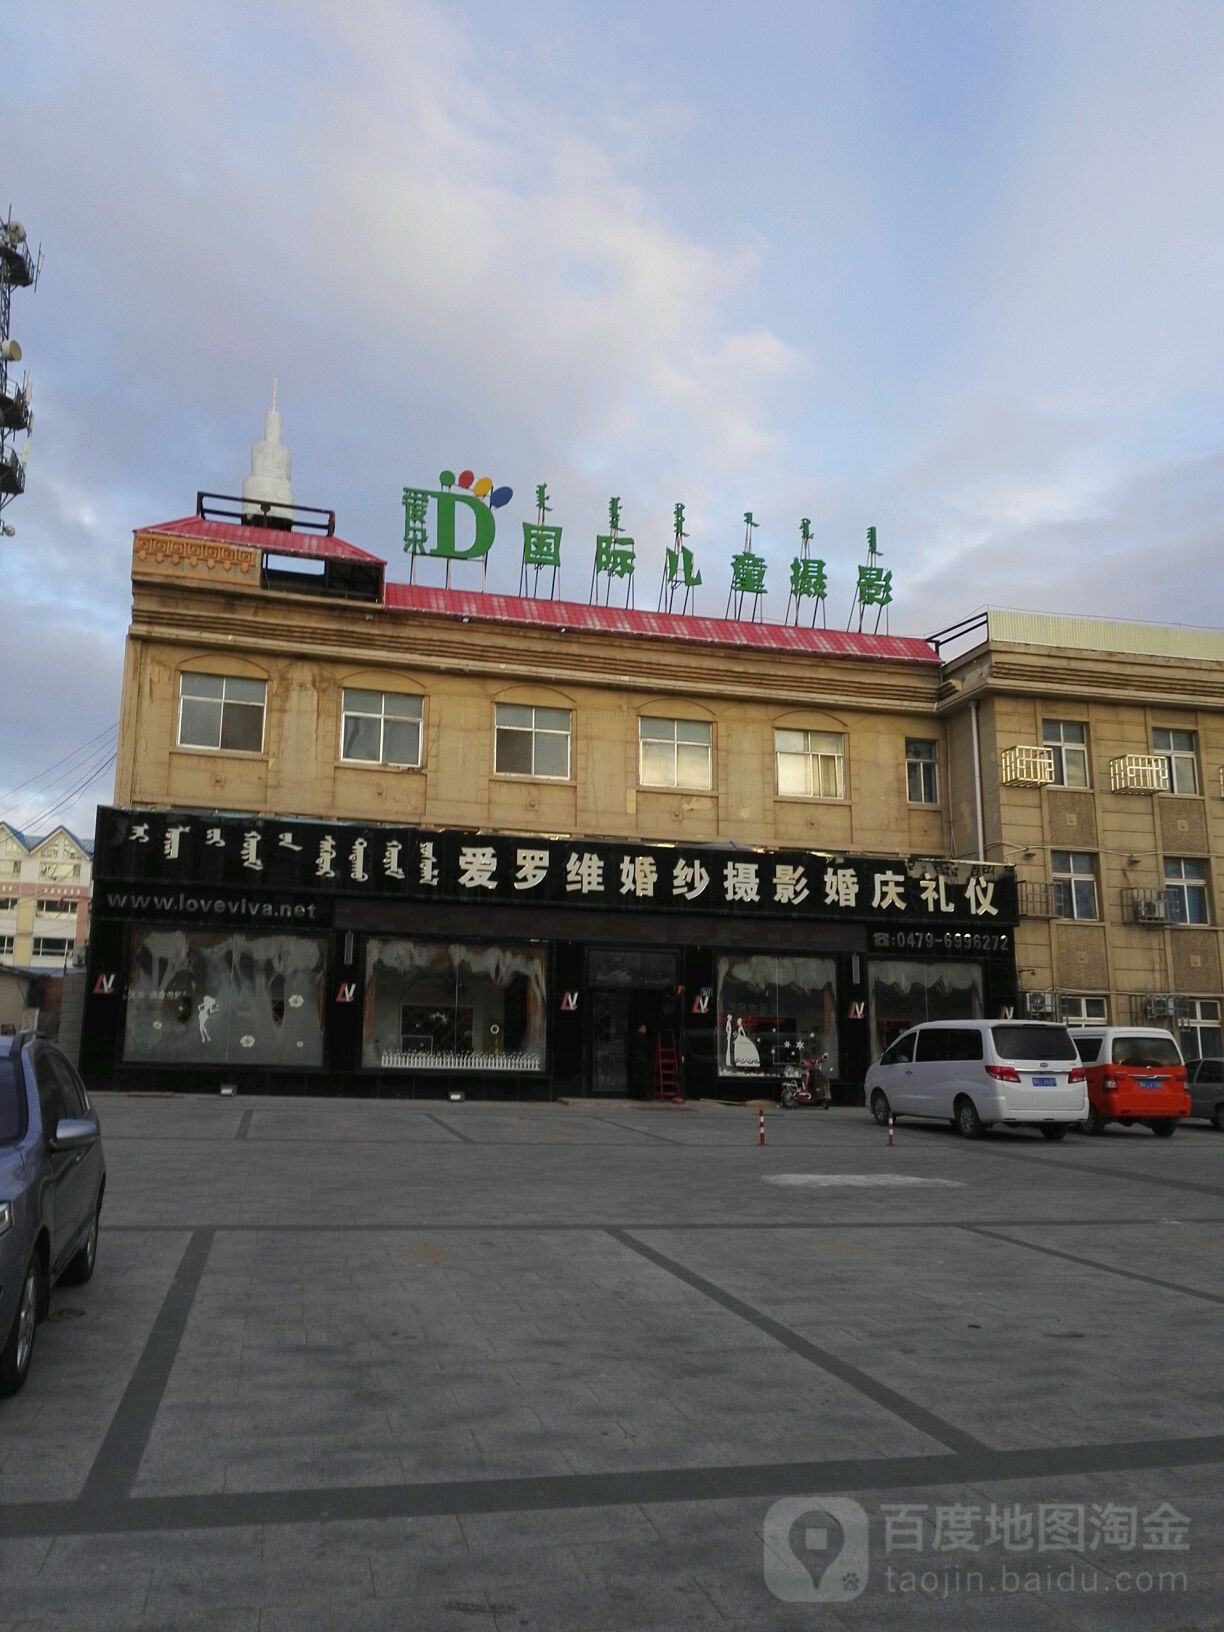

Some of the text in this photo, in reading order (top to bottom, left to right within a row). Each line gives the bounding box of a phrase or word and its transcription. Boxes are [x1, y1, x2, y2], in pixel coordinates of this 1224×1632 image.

[522, 521, 893, 606] 国际儿童摄影
[106, 891, 317, 920] www.loveviva.net
[457, 845, 1000, 916] 爱罗维婚纱摄影婚庆礼仪
